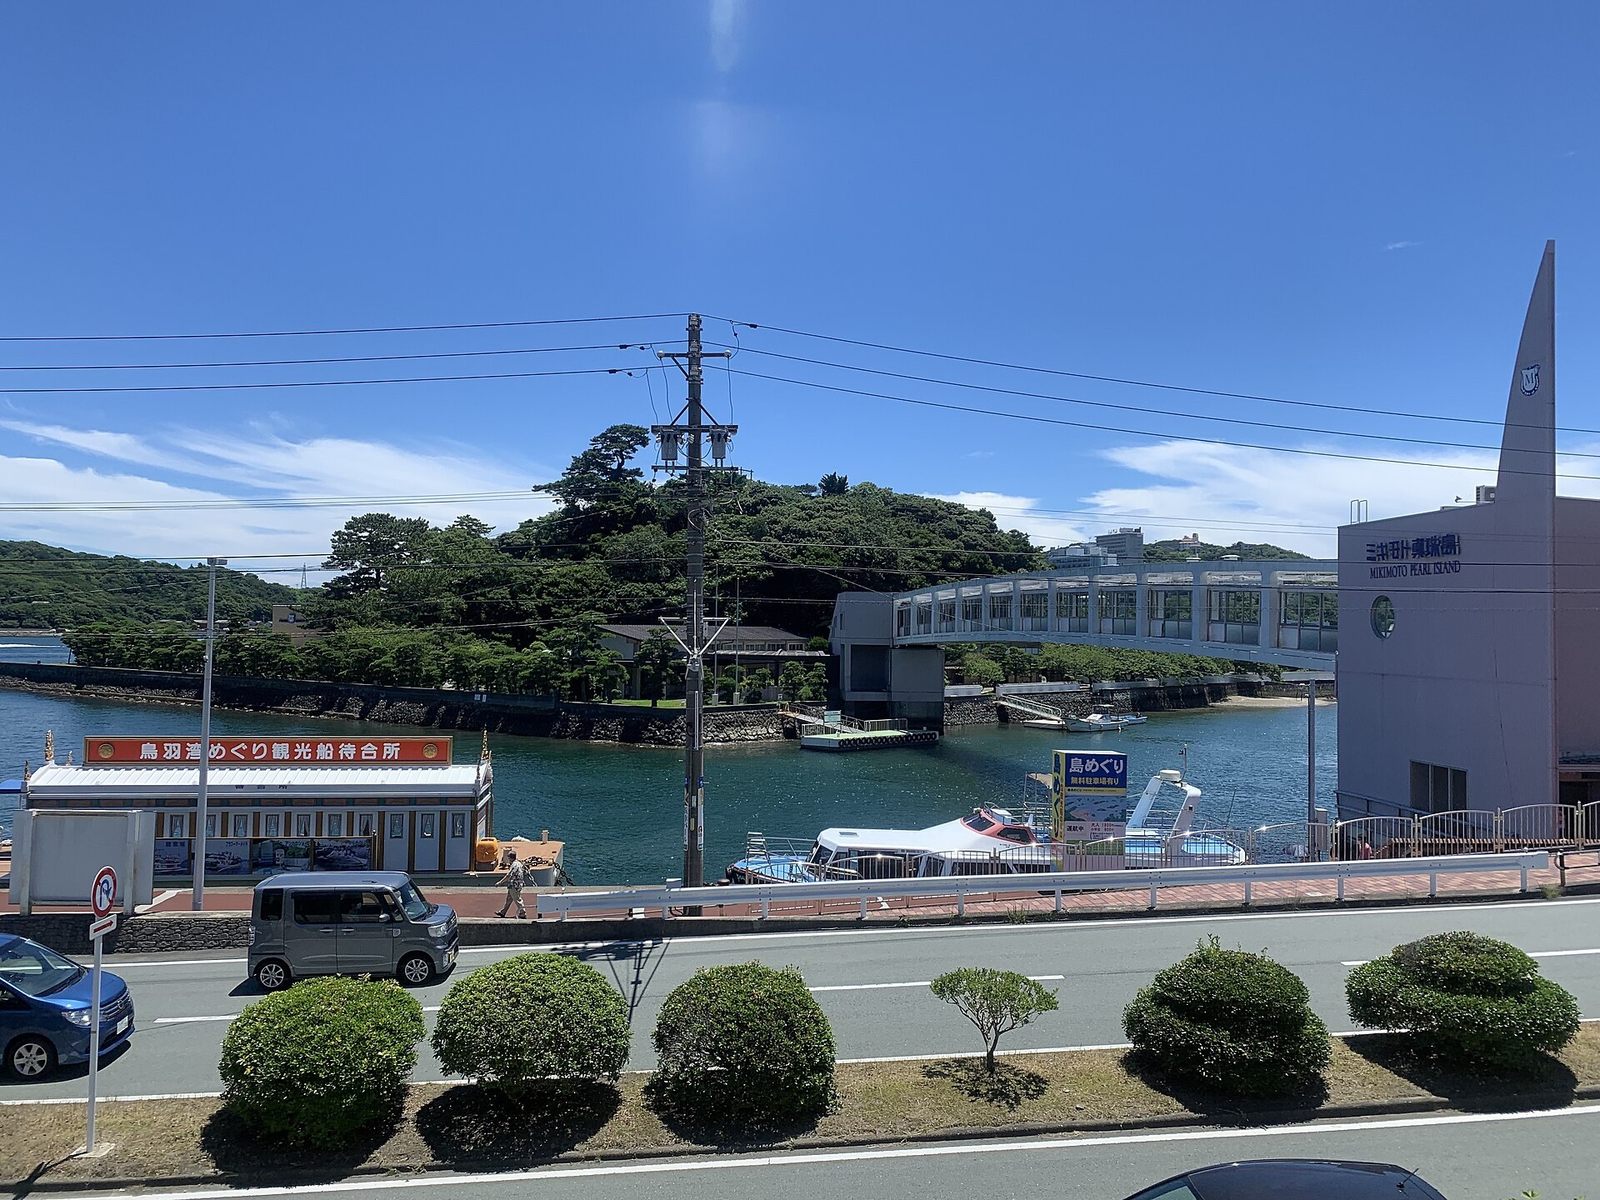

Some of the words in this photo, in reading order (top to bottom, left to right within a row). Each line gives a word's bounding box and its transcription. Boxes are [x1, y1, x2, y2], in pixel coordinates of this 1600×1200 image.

[1370, 565, 1408, 579] MIKIMOTO
[1410, 563, 1432, 576] PEARL
[1434, 560, 1461, 574] ISLAND
[1069, 757, 1124, 774] 島めぐり
